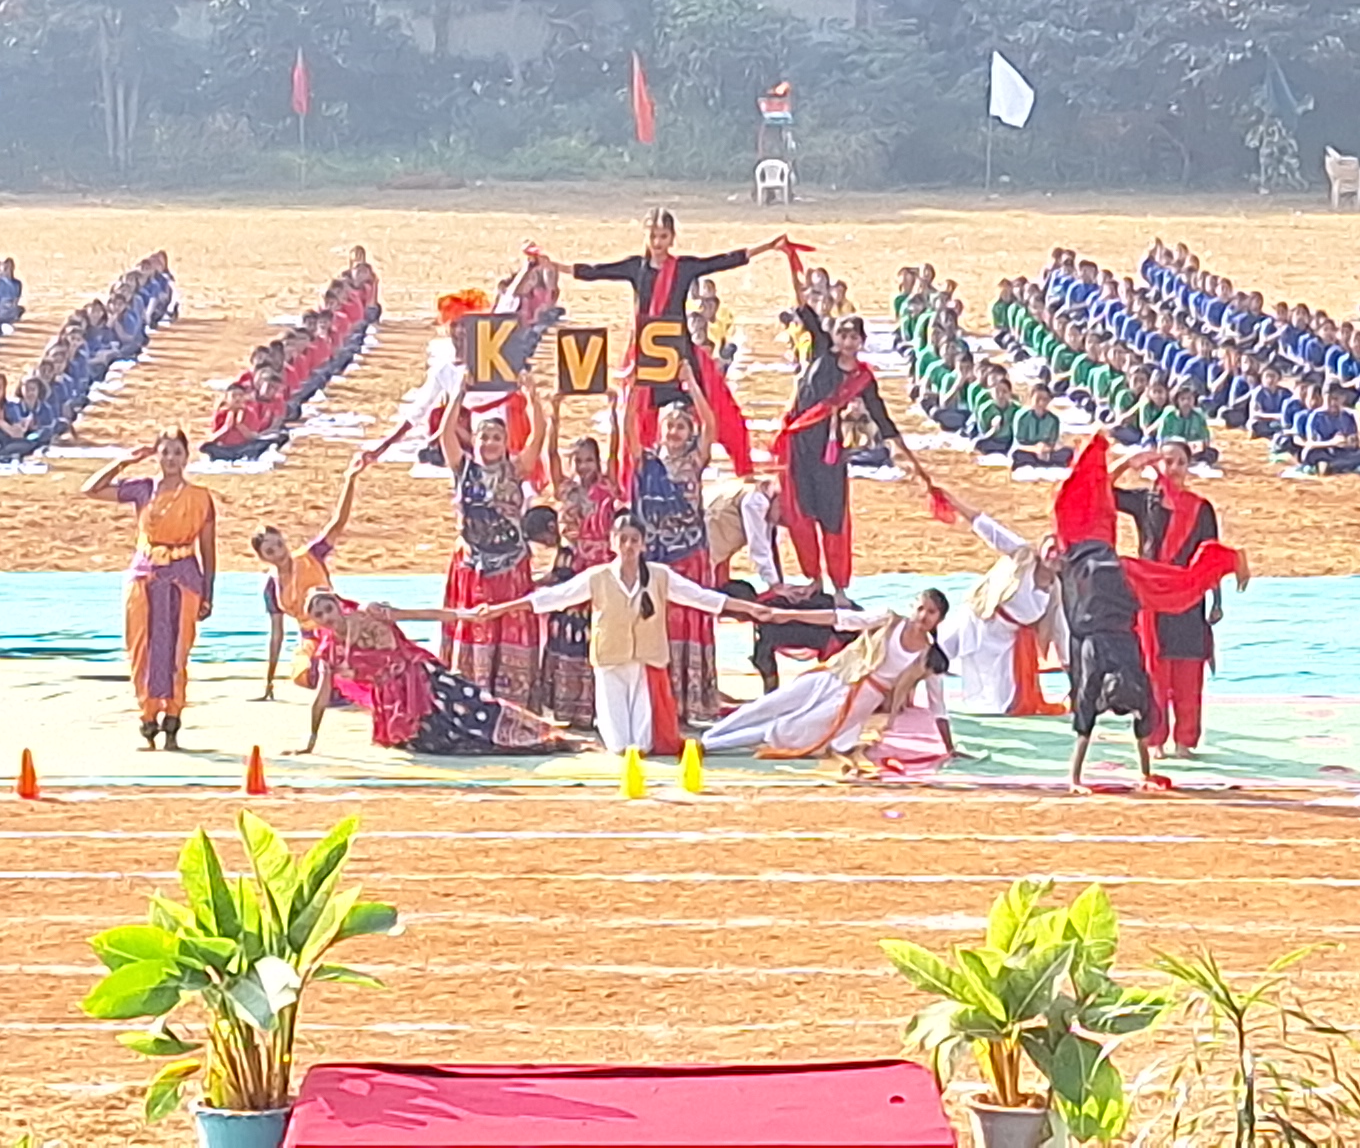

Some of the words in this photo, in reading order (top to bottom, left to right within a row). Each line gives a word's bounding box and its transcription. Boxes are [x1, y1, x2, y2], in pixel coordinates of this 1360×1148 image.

[476, 319, 518, 383] K
[561, 334, 603, 390] V
[637, 321, 682, 383] S
